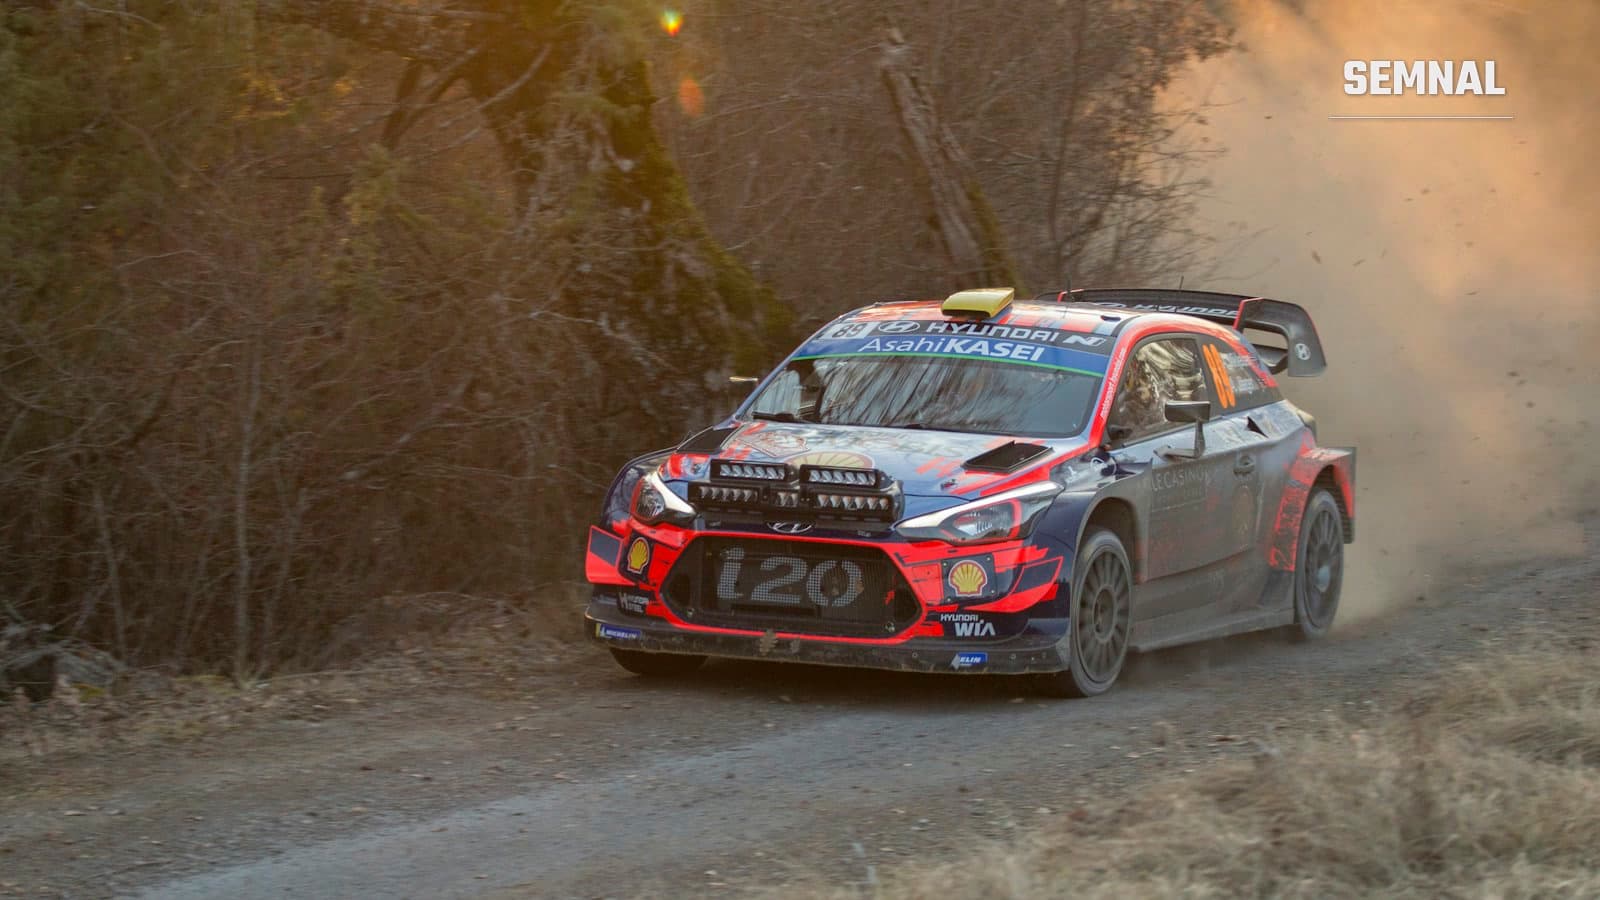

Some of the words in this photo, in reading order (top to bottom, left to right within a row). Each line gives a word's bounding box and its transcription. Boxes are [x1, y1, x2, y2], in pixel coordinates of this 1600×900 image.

[926, 322, 1059, 342] HYUNDAI
[1203, 343, 1236, 409] 89
[717, 547, 864, 608] i20
[940, 613, 979, 622] HYUNDAI
[954, 619, 996, 637] WIA
